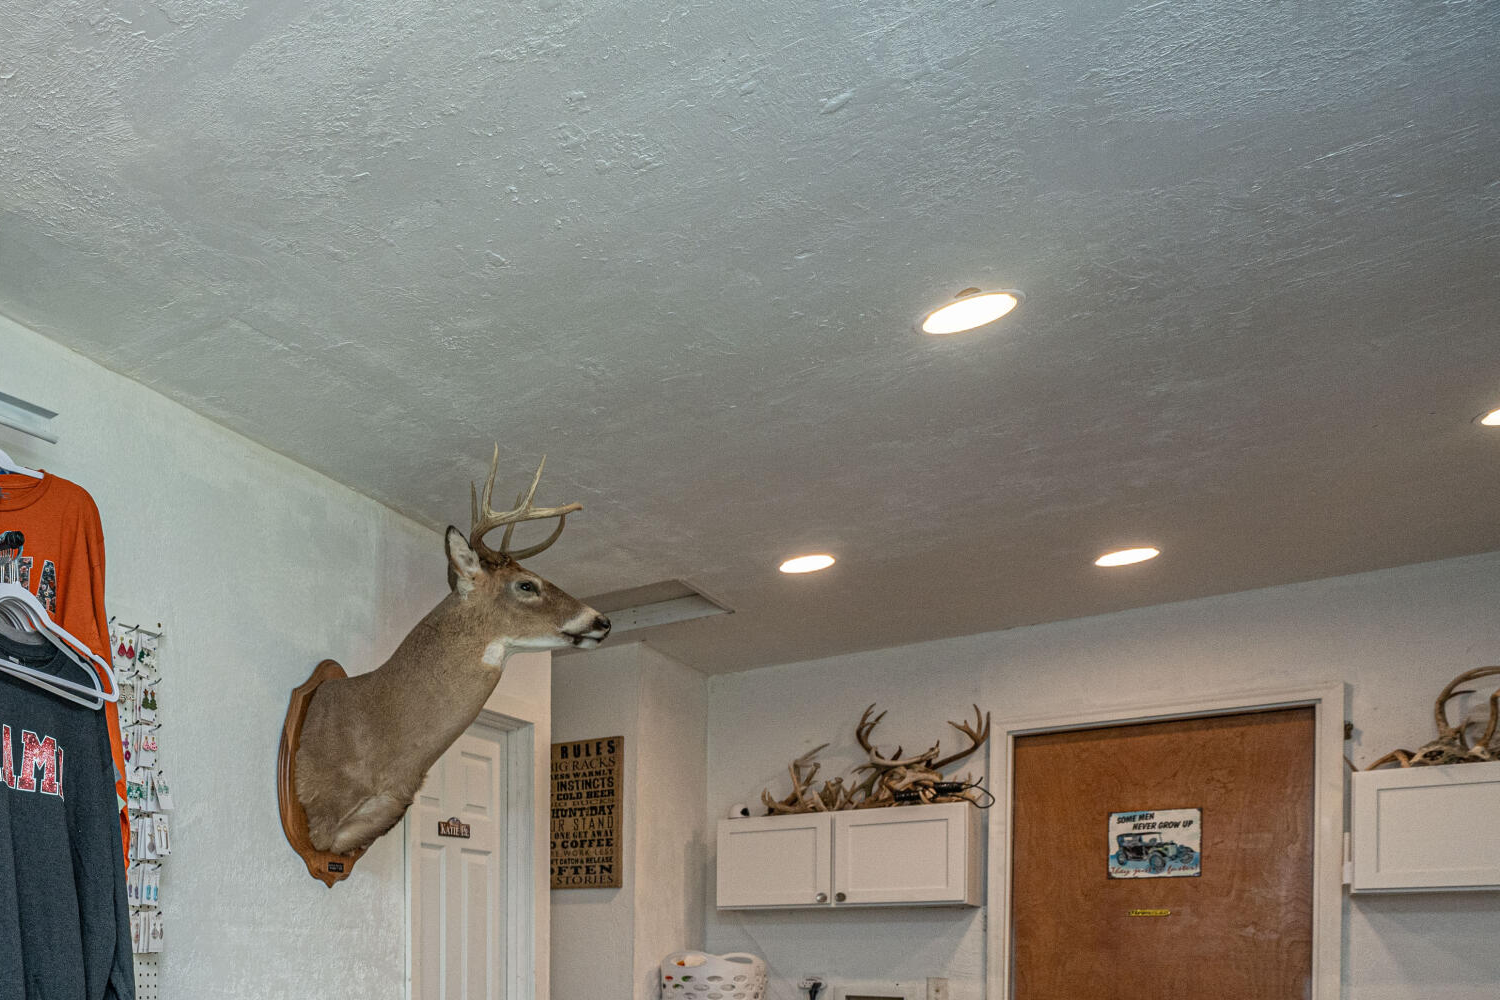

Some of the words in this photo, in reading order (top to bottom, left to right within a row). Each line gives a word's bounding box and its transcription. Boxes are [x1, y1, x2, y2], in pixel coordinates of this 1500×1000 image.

[560, 740, 616, 759] RULES
[572, 757, 616, 771] RACKS
[556, 776, 614, 793] INSTINCTS
[556, 791, 583, 801] COLD
[586, 789, 615, 799] BEER
[589, 804, 616, 817] DAY
[573, 815, 614, 831] STAND
[1117, 815, 1137, 824] SOME
[1132, 821, 1157, 831] NEVER
[1158, 820, 1181, 829] GROW
[1182, 819, 1194, 828] UP
[572, 830, 588, 839] GET
[561, 838, 613, 849] COFFEE
[585, 856, 613, 864] RELEASE
[556, 875, 614, 885] STORIES
